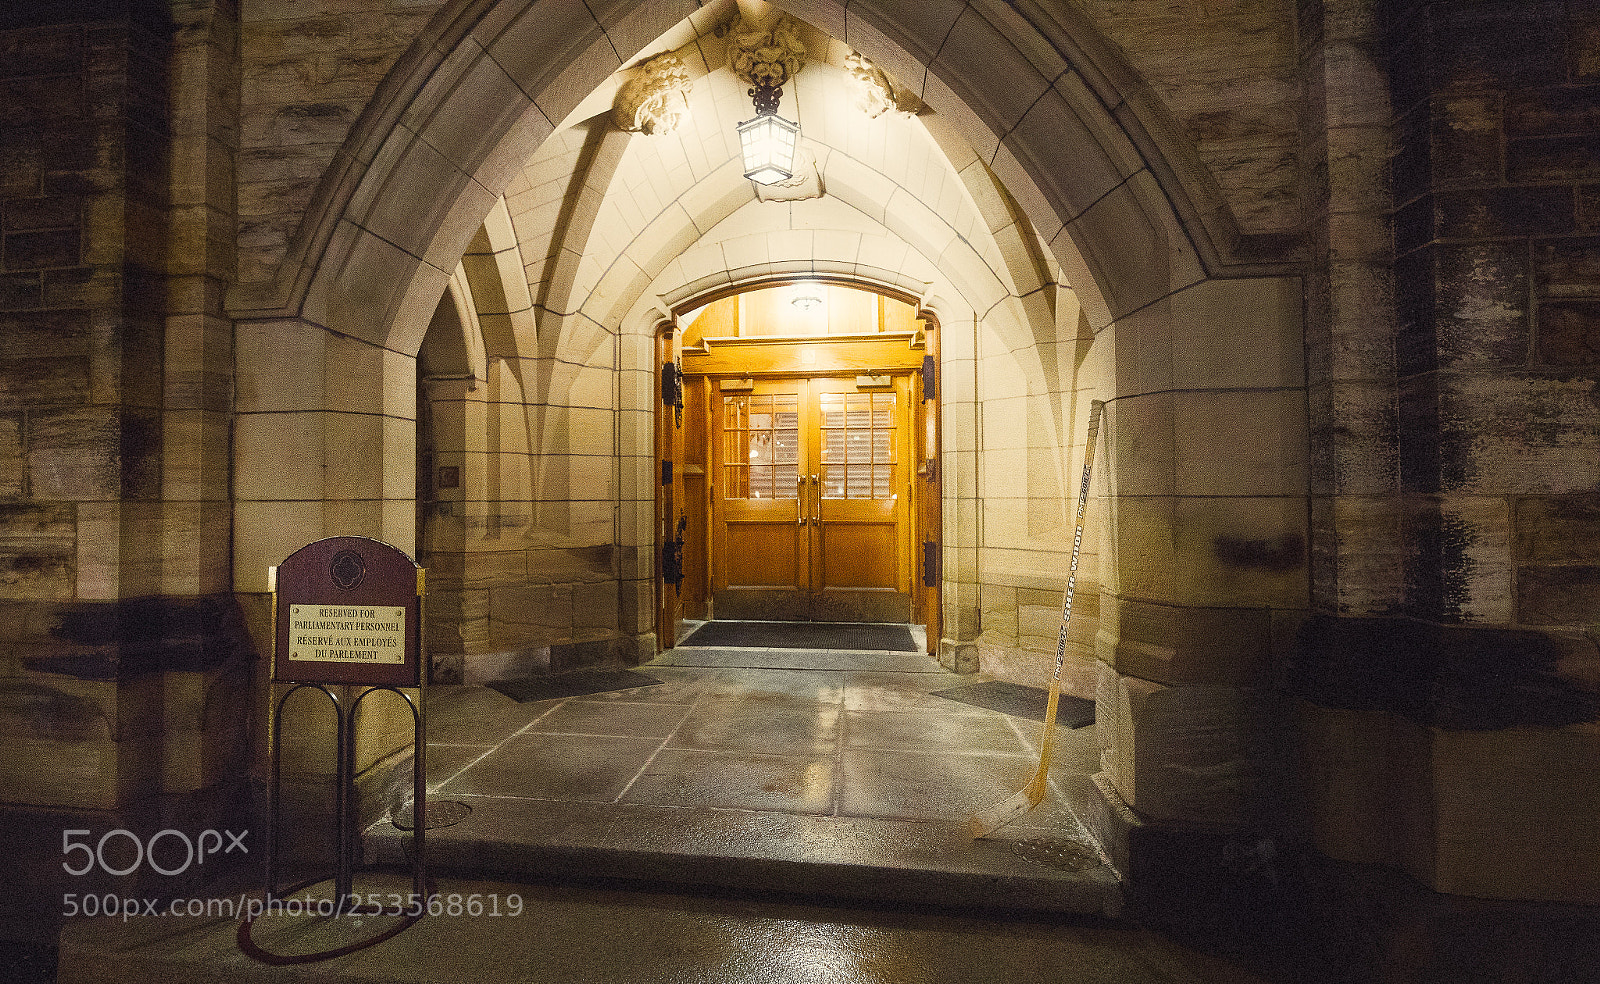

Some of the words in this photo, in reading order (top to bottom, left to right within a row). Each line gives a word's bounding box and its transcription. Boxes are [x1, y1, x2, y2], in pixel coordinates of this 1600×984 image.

[319, 608, 358, 618] RESERVED
[360, 609, 375, 619] FOR
[294, 621, 354, 631] PARLIAMENTARY
[355, 622, 400, 632] PERSONNEL
[296, 634, 334, 646] RÉSERVÉ
[335, 637, 352, 647] AUX
[354, 636, 397, 648] EMPLOYÉS
[315, 649, 327, 658] DU
[329, 649, 379, 660] PARLEMENT
